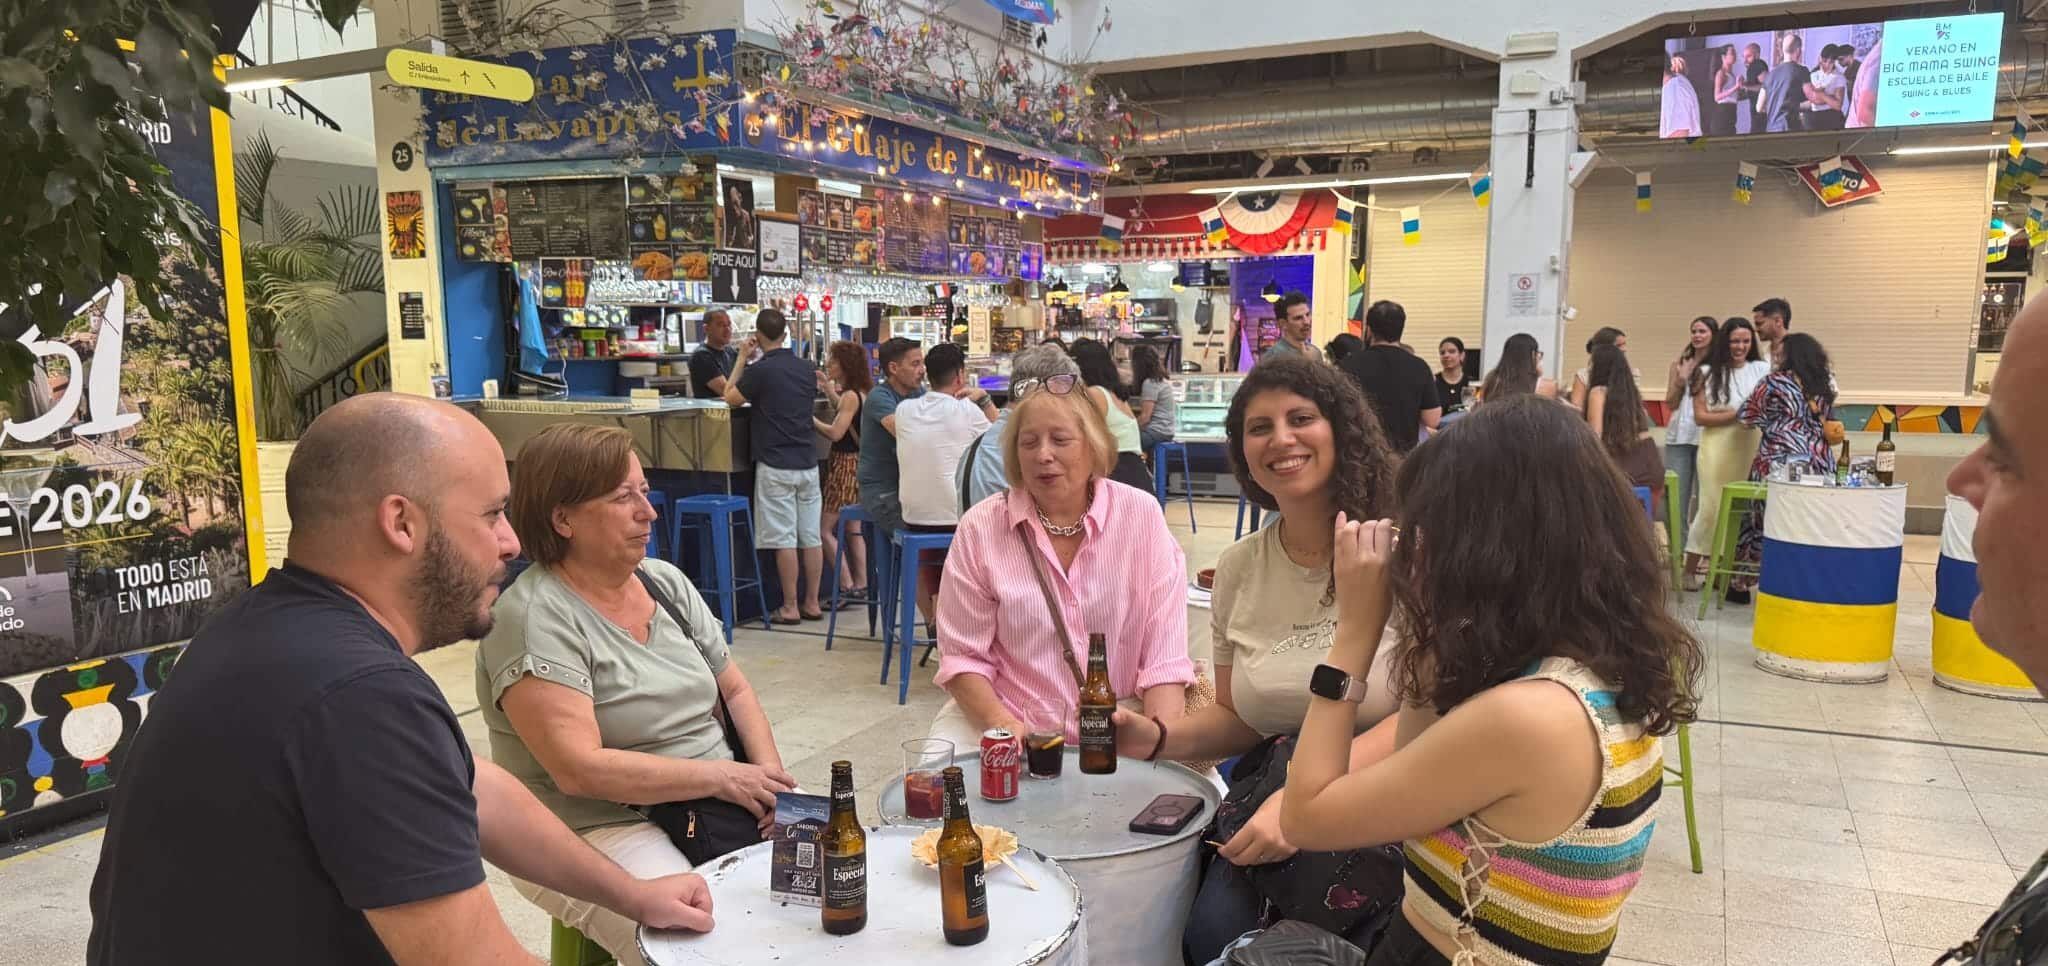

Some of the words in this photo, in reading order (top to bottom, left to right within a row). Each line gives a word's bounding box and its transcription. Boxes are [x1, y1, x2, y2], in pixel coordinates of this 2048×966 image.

[1906, 44, 1958, 56] VERANO
[1960, 42, 1977, 53] EN
[408, 61, 439, 74] Salida
[1883, 63, 1904, 73] BIG
[1909, 60, 1949, 72] MAMA
[1953, 56, 1996, 68] SWING
[1887, 76, 1936, 87] ESCUELA
[1939, 74, 1954, 83] DE
[1956, 72, 1989, 82] BAILE
[1902, 89, 1930, 98] SWING
[1942, 87, 1972, 96] BLUES
[748, 124, 760, 137] 25
[776, 103, 812, 143] El
[826, 114, 917, 174] Guaje
[926, 136, 957, 175] de
[395, 151, 409, 163] 25
[712, 253, 733, 266] PIDE
[31, 479, 152, 534] 2026
[115, 562, 164, 590] TODO
[169, 550, 209, 581] ESTÁ
[117, 590, 142, 614] EN
[147, 578, 212, 609] MADRID
[983, 743, 1017, 769] Cola
[833, 864, 865, 881] Especial
